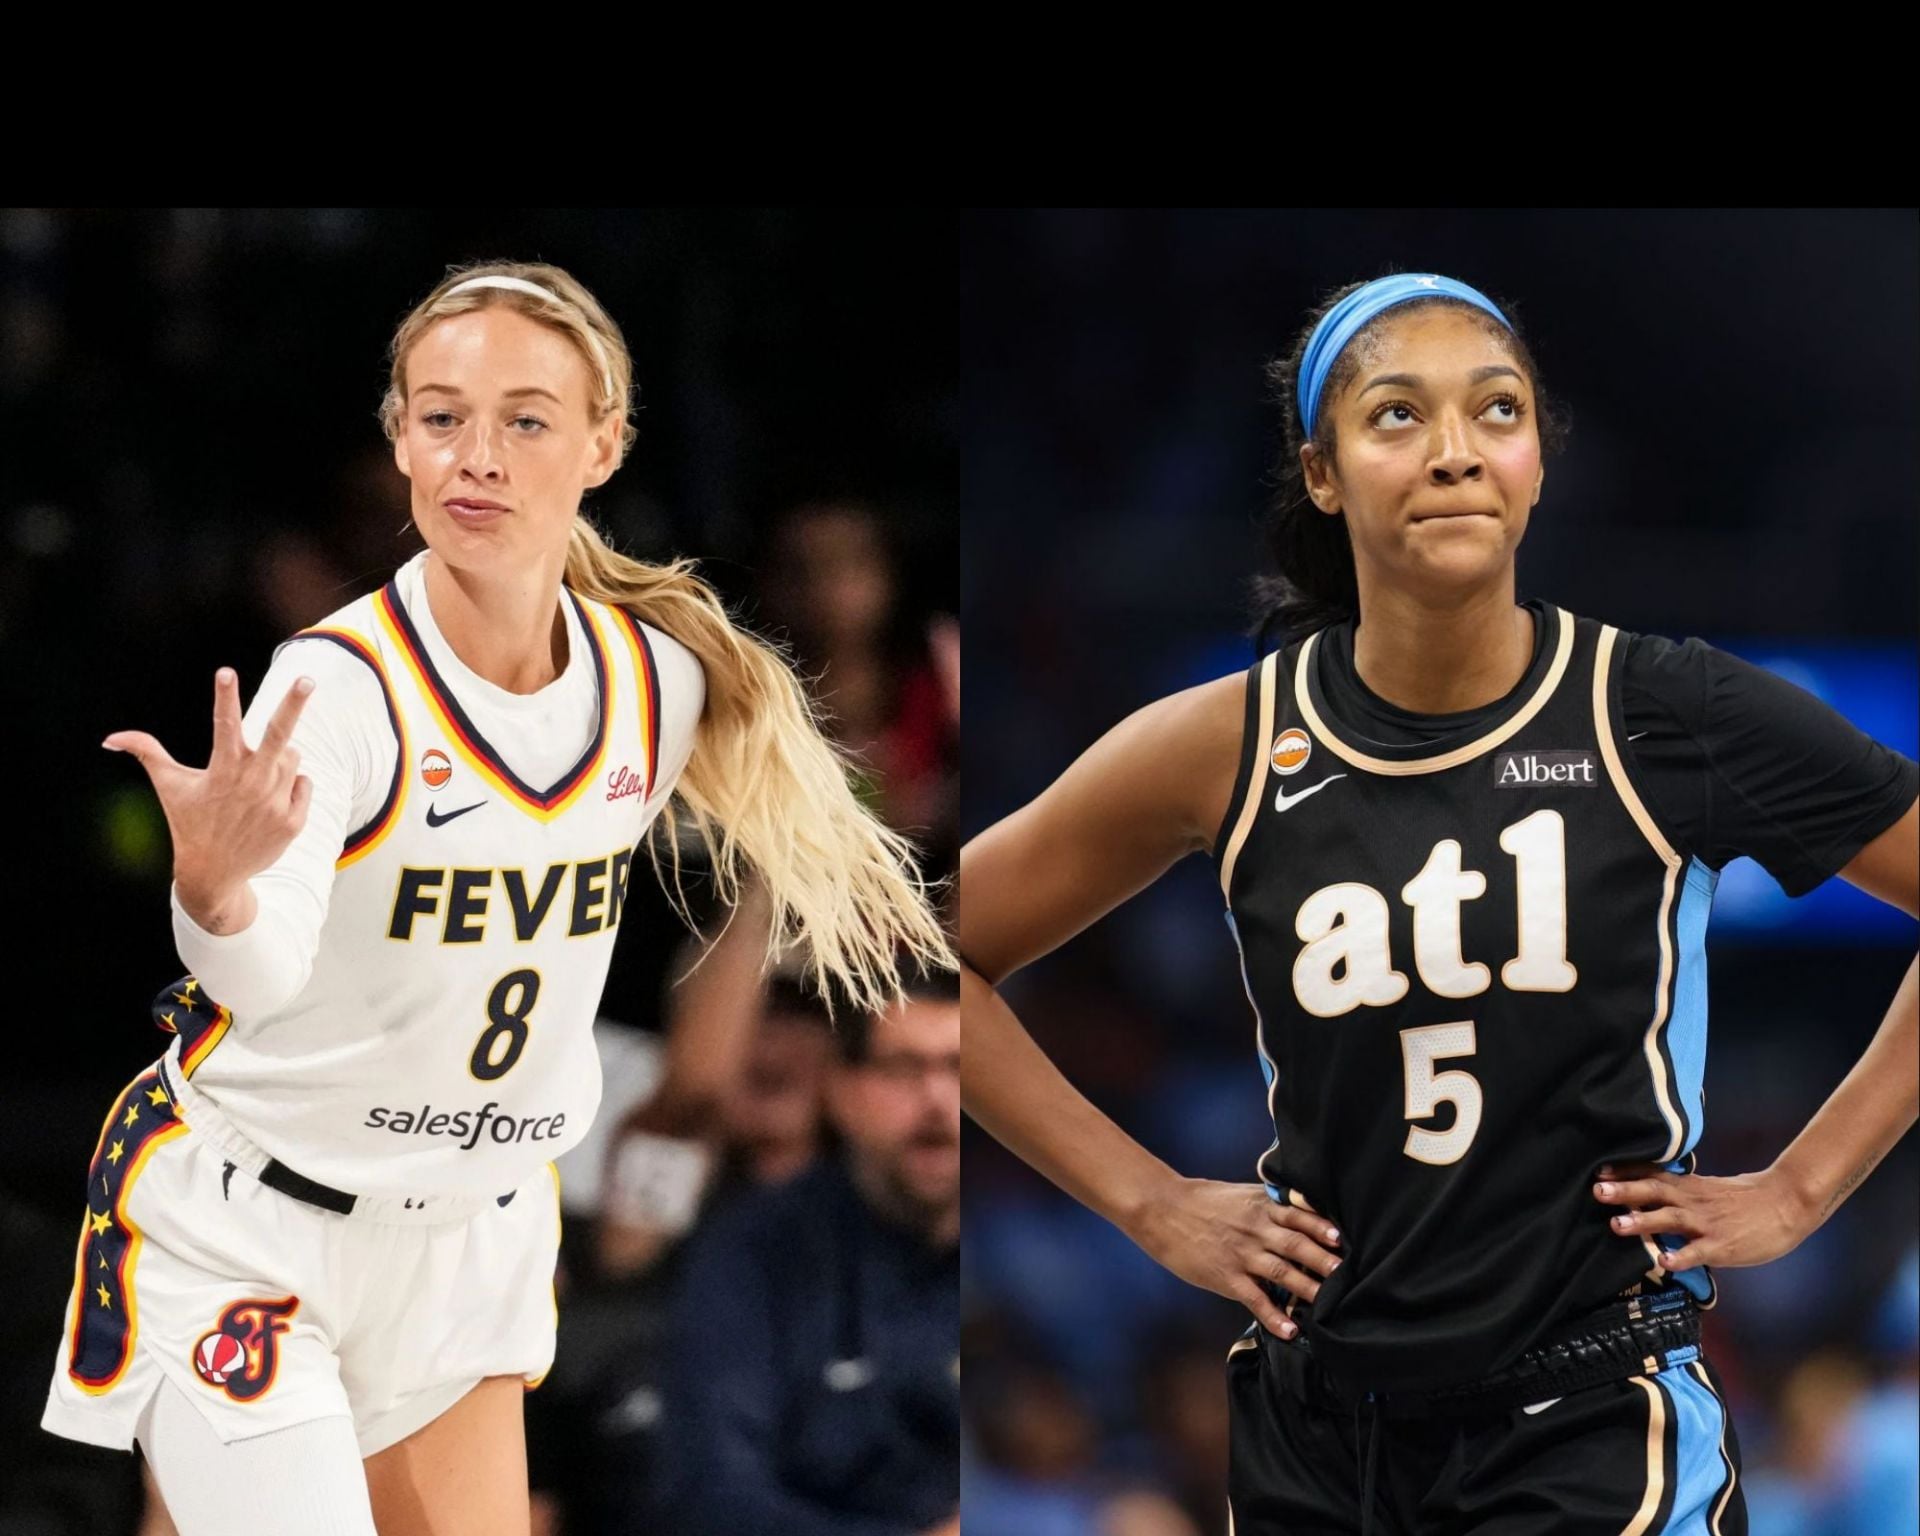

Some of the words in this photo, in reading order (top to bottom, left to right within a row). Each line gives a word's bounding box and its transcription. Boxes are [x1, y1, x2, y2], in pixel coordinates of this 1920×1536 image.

[606, 765, 645, 803] Lilly
[1499, 755, 1594, 784] Albert
[385, 845, 632, 945] FEVER
[1292, 809, 1578, 1018] atl
[467, 966, 543, 1084] 8
[364, 1101, 566, 1151] salesforce
[1400, 1019, 1483, 1166] 5
